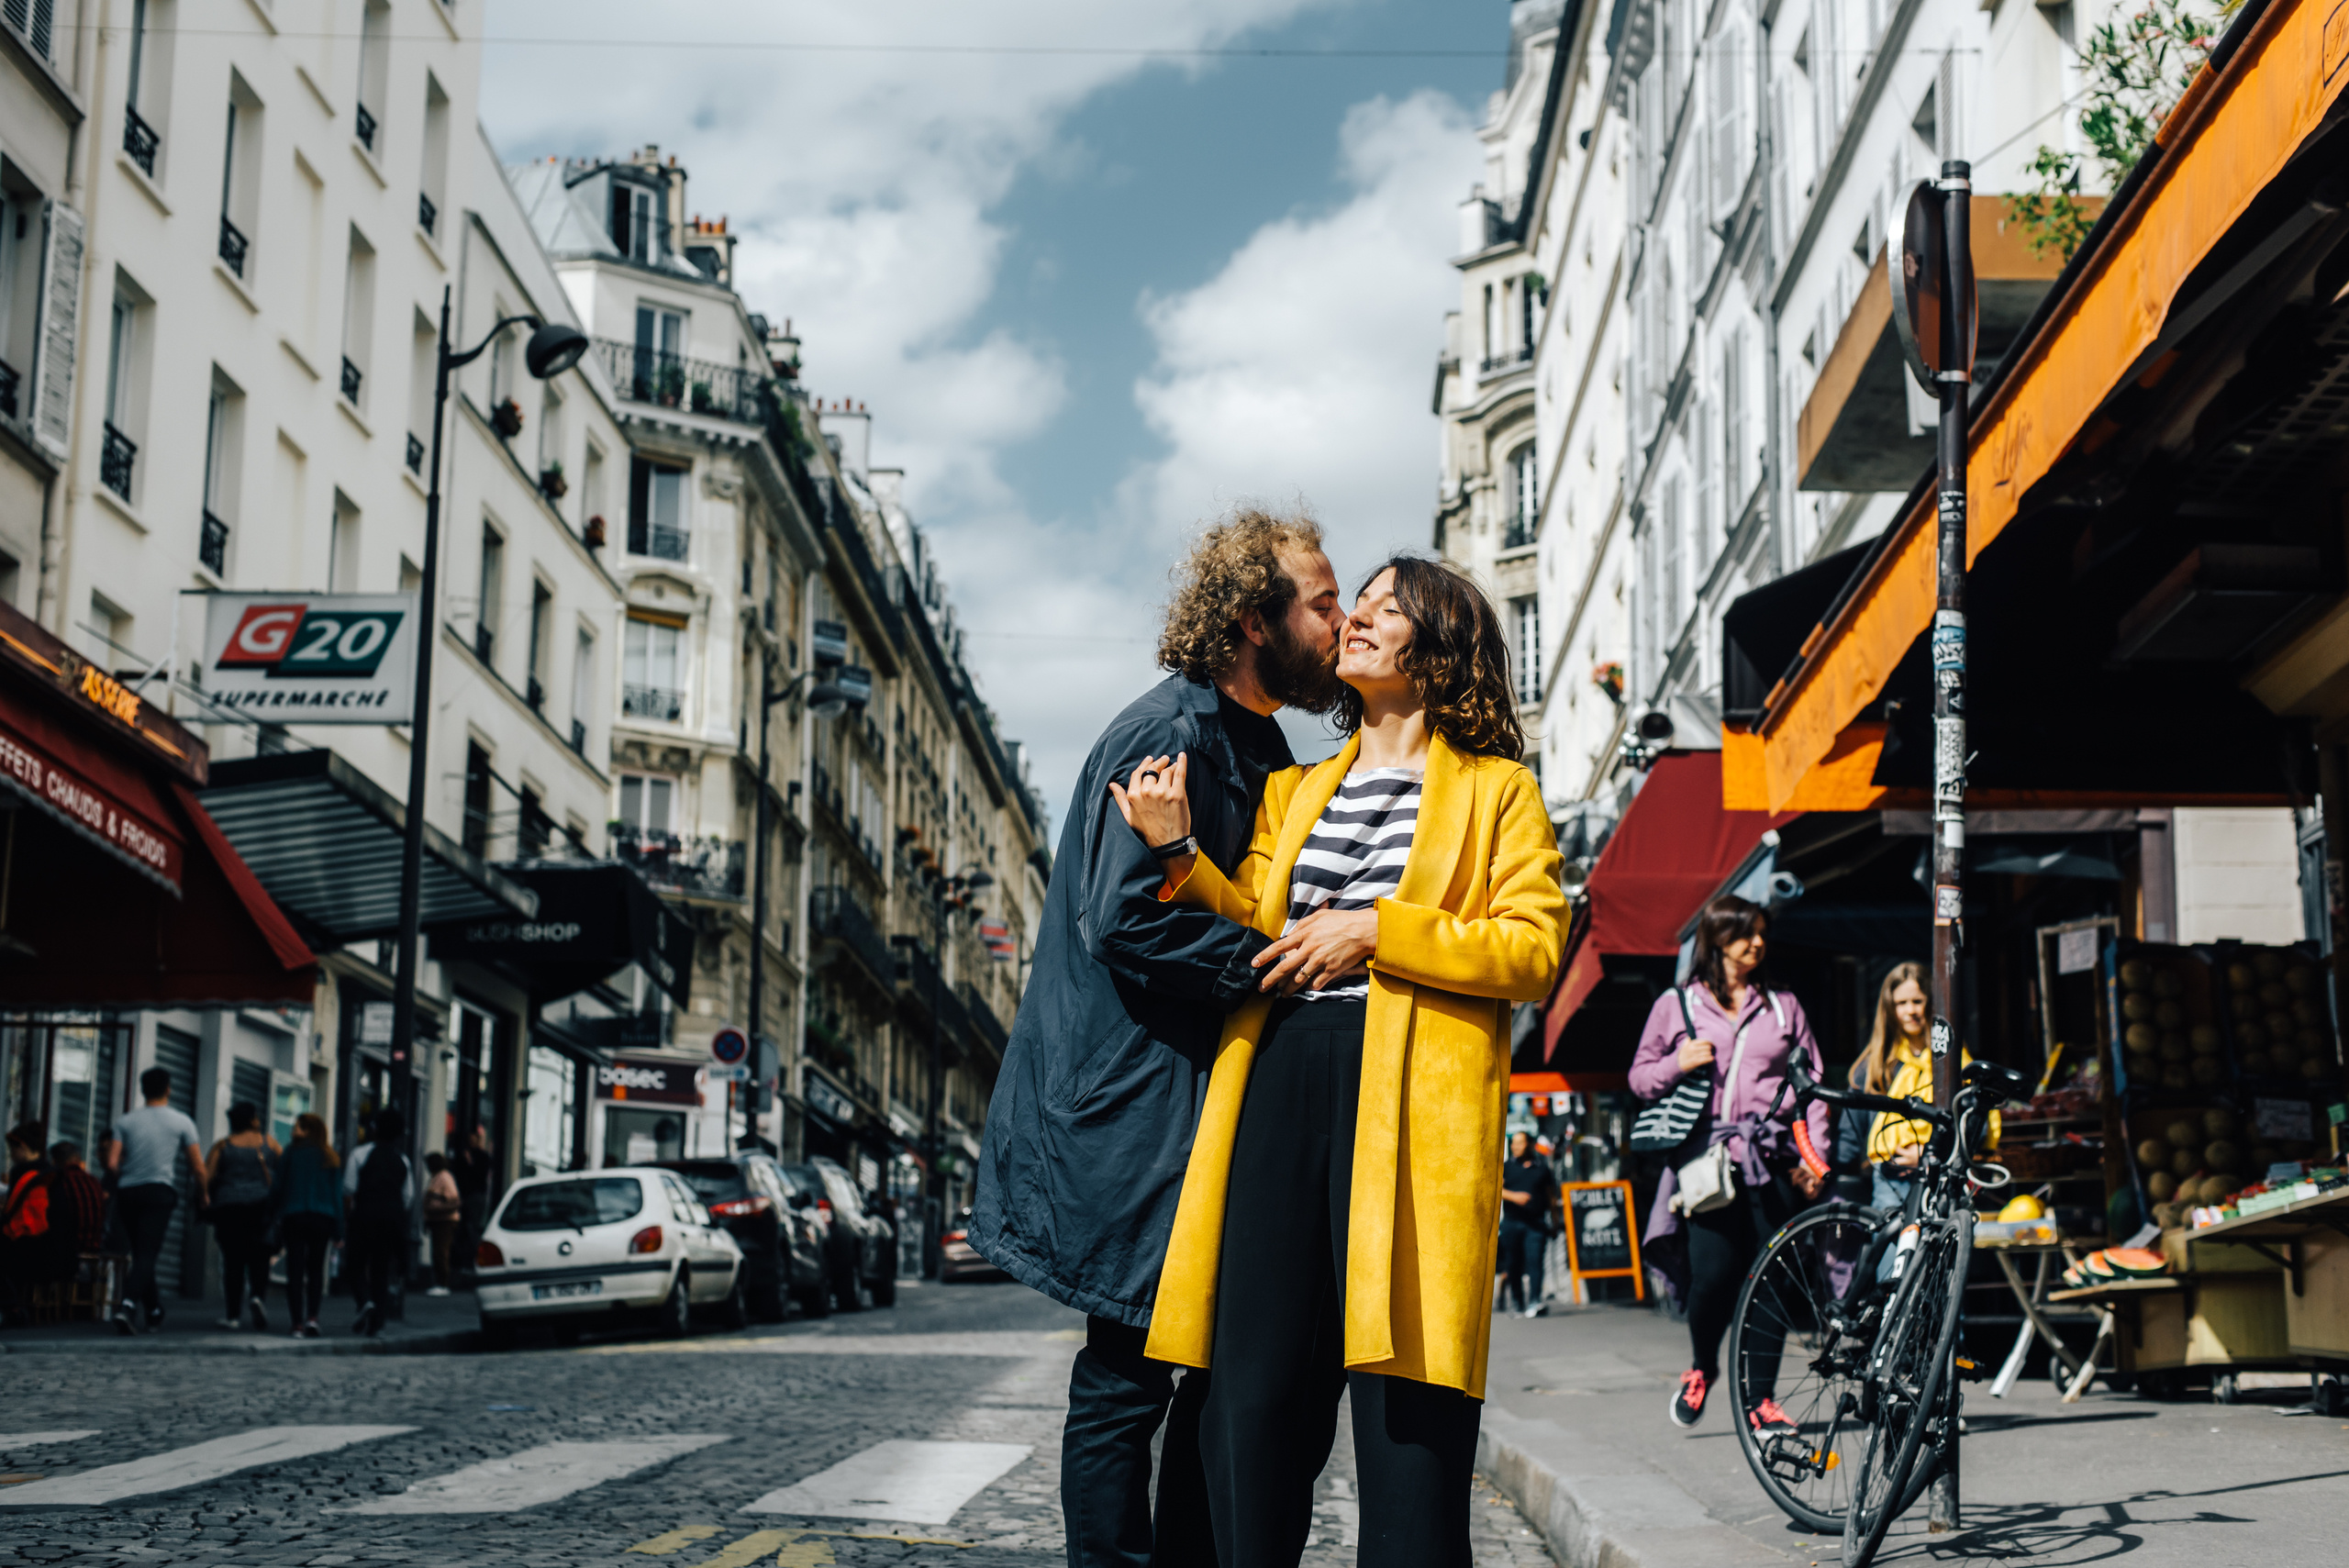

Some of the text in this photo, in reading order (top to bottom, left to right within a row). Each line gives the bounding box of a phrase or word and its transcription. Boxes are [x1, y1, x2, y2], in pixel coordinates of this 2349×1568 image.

[239, 610, 396, 662] G20
[47, 771, 104, 828] CHAUDS
[106, 809, 117, 838] &
